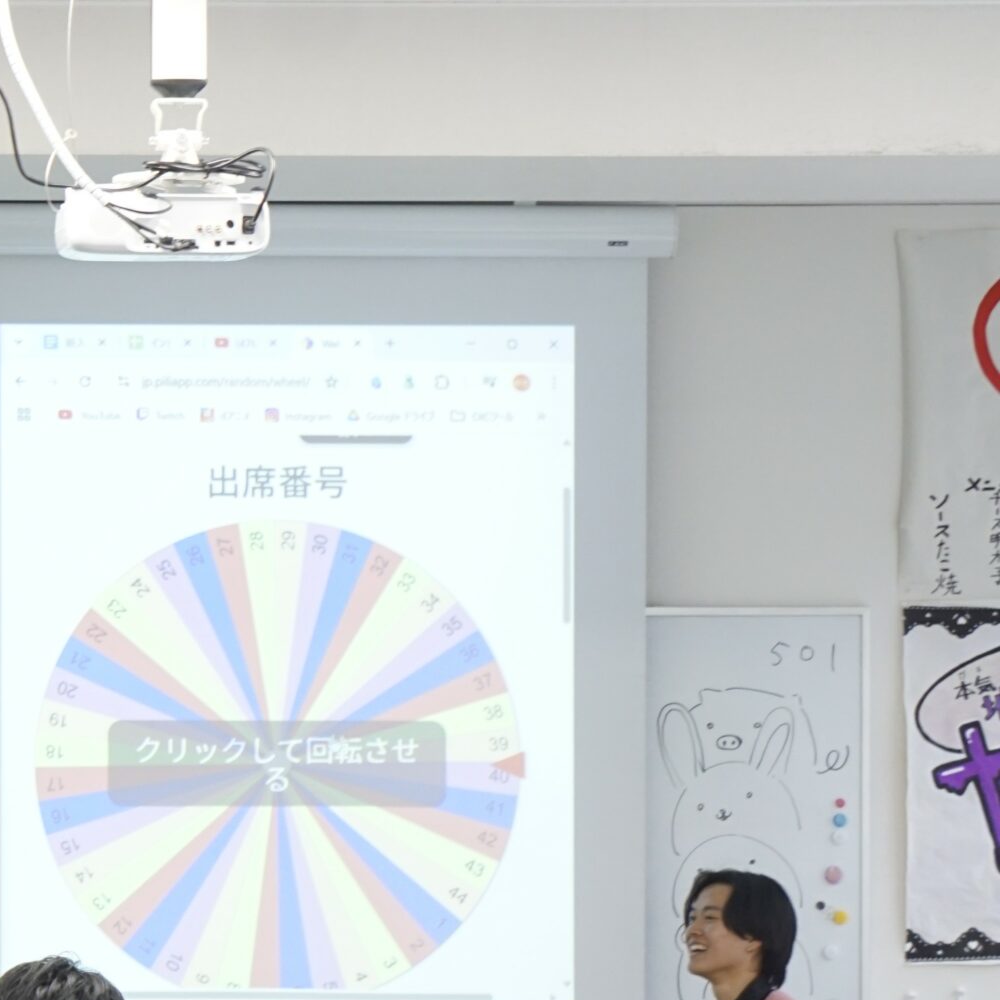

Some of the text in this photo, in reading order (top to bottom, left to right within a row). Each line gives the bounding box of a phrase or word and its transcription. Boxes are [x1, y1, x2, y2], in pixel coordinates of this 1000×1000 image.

[141, 375, 311, 390] jp.piliapp.com/random/wheel/
[80, 410, 121, 421] YouTube
[155, 410, 185, 421] Twitch
[284, 411, 332, 423] Instagram
[365, 410, 436, 423] Google ドライブ
[207, 464, 348, 500] 出席番号
[216, 537, 233, 557] 27
[250, 531, 265, 550] 28
[281, 530, 296, 550] 29
[312, 535, 327, 554] 30
[156, 559, 176, 579] 25
[370, 555, 389, 576] 32
[130, 577, 150, 599] 24
[397, 572, 416, 592] 33
[107, 599, 127, 619] 23
[420, 593, 440, 613] 34
[85, 625, 107, 643] 22
[441, 616, 463, 636] 35
[770, 641, 837, 673] 501
[57, 681, 79, 698] 20
[473, 673, 492, 691] 37
[50, 711, 68, 727] 19
[483, 703, 503, 721] 38
[46, 744, 64, 759] 18
[136, 736, 420, 765] クリックして回転させ
[489, 737, 507, 752] 39
[47, 776, 64, 792] 17
[266, 766, 289, 793] る
[51, 807, 71, 824] 16
[485, 800, 504, 816] 41
[60, 839, 80, 855] 15
[477, 831, 497, 847] 42
[74, 866, 96, 884] 14
[464, 860, 485, 877] 43
[92, 892, 114, 910] 13
[448, 887, 468, 904] 44
[113, 918, 133, 935] 12
[408, 937, 425, 951] 2
[166, 954, 183, 972] 10
[381, 957, 398, 969] 3
[355, 971, 368, 981] 4
